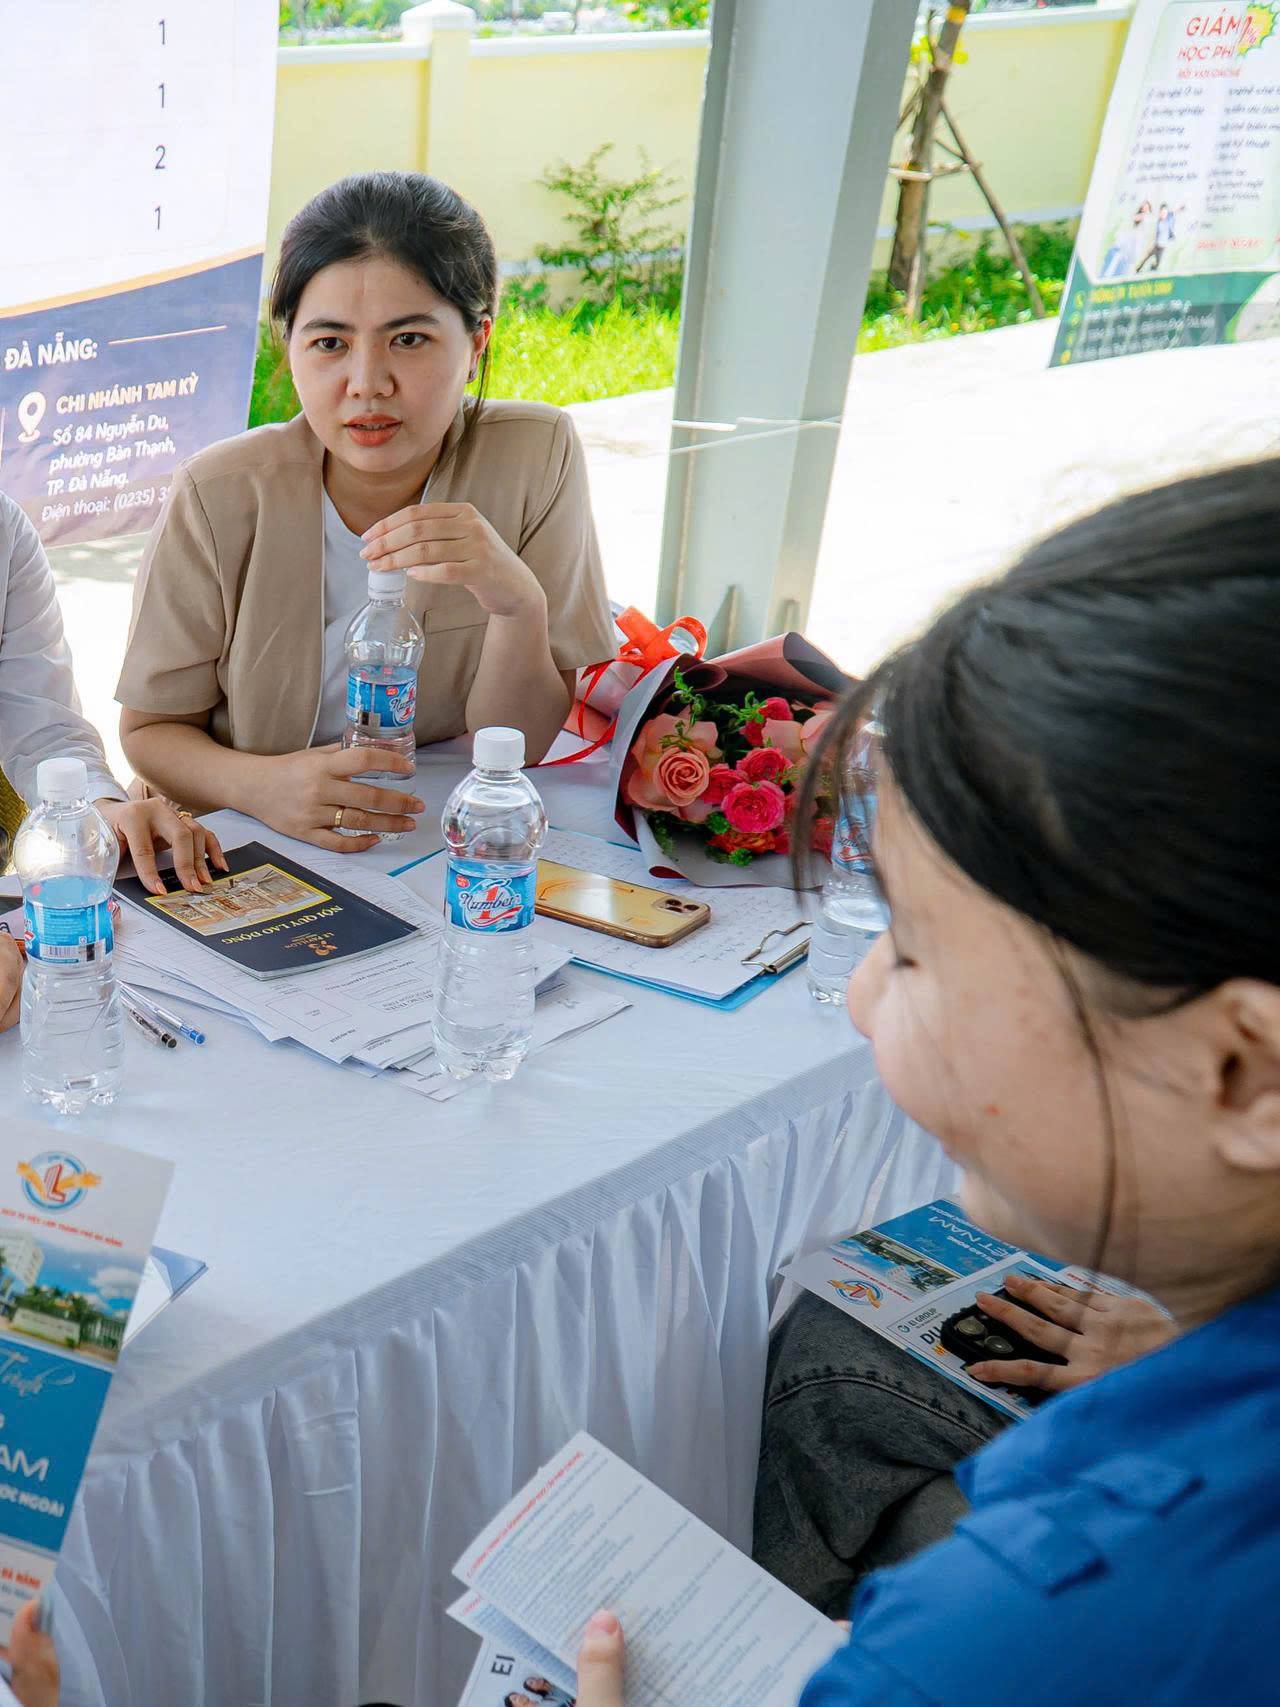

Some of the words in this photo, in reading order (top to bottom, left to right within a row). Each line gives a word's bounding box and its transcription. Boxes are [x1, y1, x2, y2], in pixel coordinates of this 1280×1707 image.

[157, 19, 166, 45] 1
[157, 82, 166, 109] 1
[154, 145, 166, 170] 2
[154, 205, 162, 231] 1
[4, 340, 33, 371] ĐÀ
[37, 331, 99, 367] NẴNG:
[56, 393, 85, 415] CHI
[88, 384, 142, 411] NHÁNH
[145, 379, 177, 401] TAM
[178, 371, 199, 396] KỲ
[52, 424, 73, 447] Số
[74, 424, 93, 443] 84
[95, 414, 144, 442] Nguyễn
[49, 451, 103, 475] phường
[106, 444, 132, 463] Bàn
[46, 478, 64, 497] TP.
[68, 476, 88, 493] Đà
[90, 468, 130, 490] Nẵng.
[41, 502, 71, 522] Điện
[74, 496, 111, 516] thoại:
[113, 486, 156, 512] (0235)
[460, 892, 520, 911] Number
[262, 923, 291, 935] LAO
[290, 914, 318, 928] QUY
